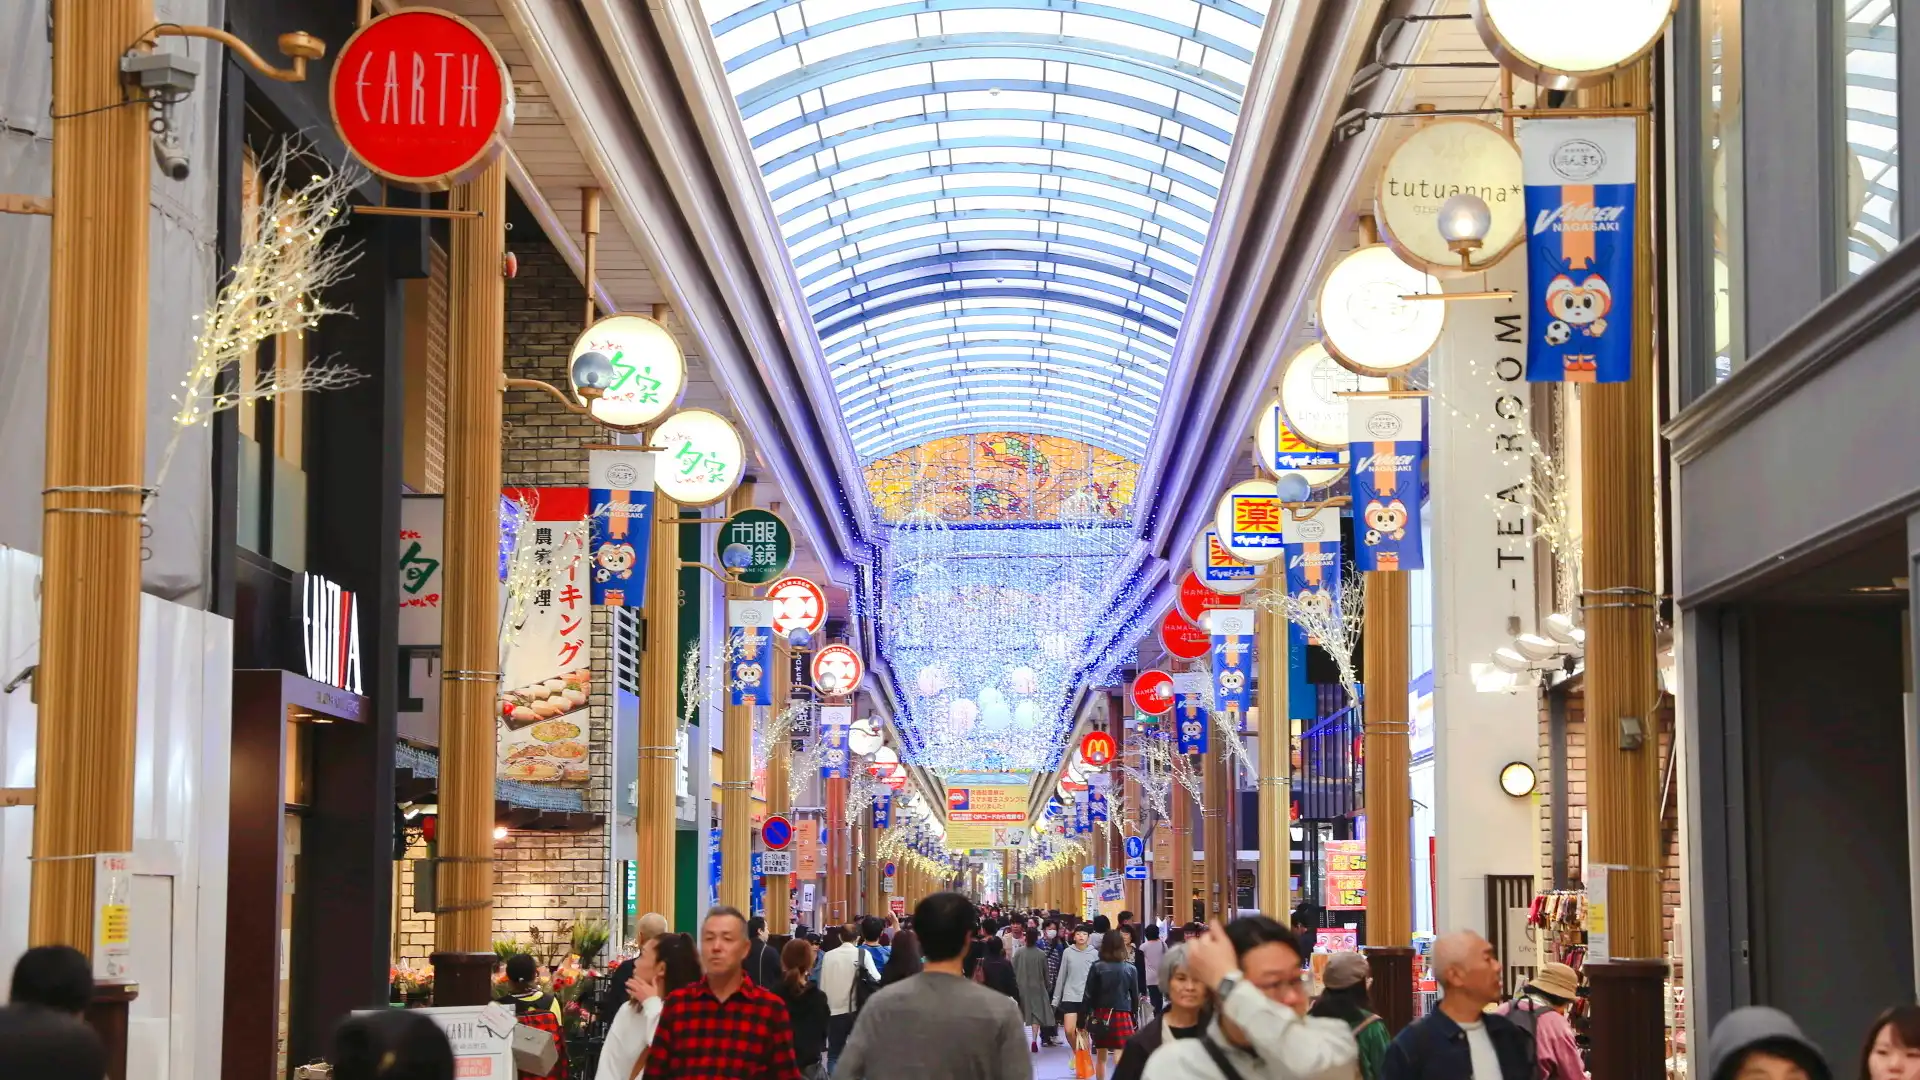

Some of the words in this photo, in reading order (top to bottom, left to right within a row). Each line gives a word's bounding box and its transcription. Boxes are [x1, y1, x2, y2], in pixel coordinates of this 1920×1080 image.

[355, 51, 479, 127] EARTH
[1553, 222, 1619, 232] NAGASAKI
[1236, 499, 1279, 532] 薬
[557, 528, 586, 667] バイキング
